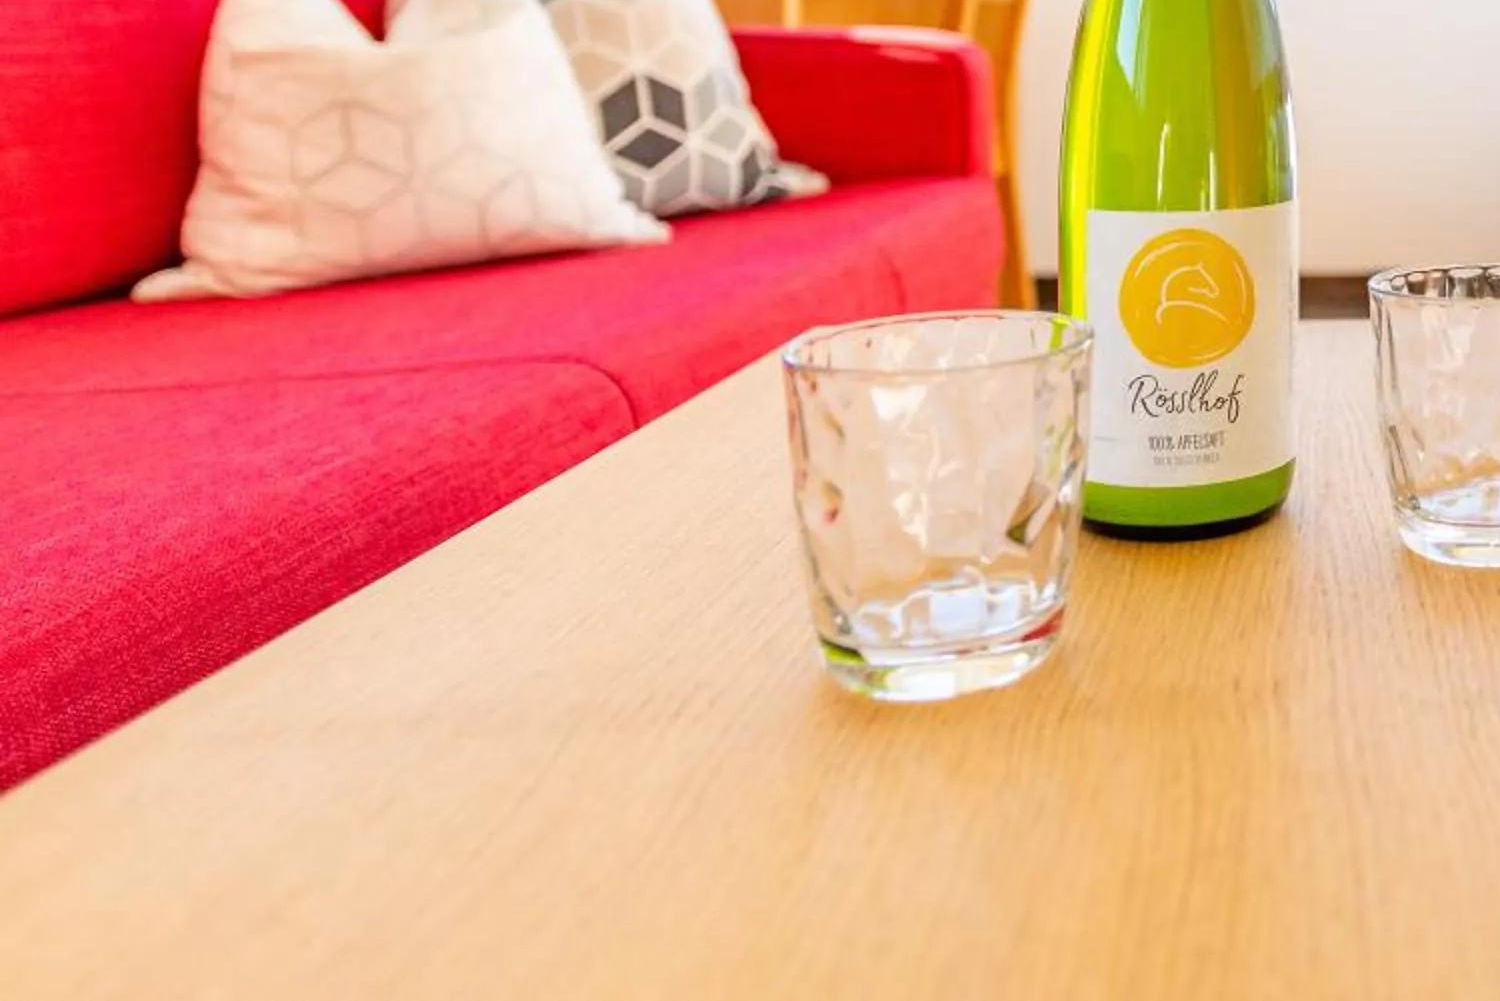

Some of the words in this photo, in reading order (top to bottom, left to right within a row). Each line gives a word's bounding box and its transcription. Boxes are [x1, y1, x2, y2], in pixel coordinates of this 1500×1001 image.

[1128, 369, 1244, 423] Rösslhof
[1149, 435, 1174, 451] 100%
[1178, 431, 1225, 449] APFELSAFT
